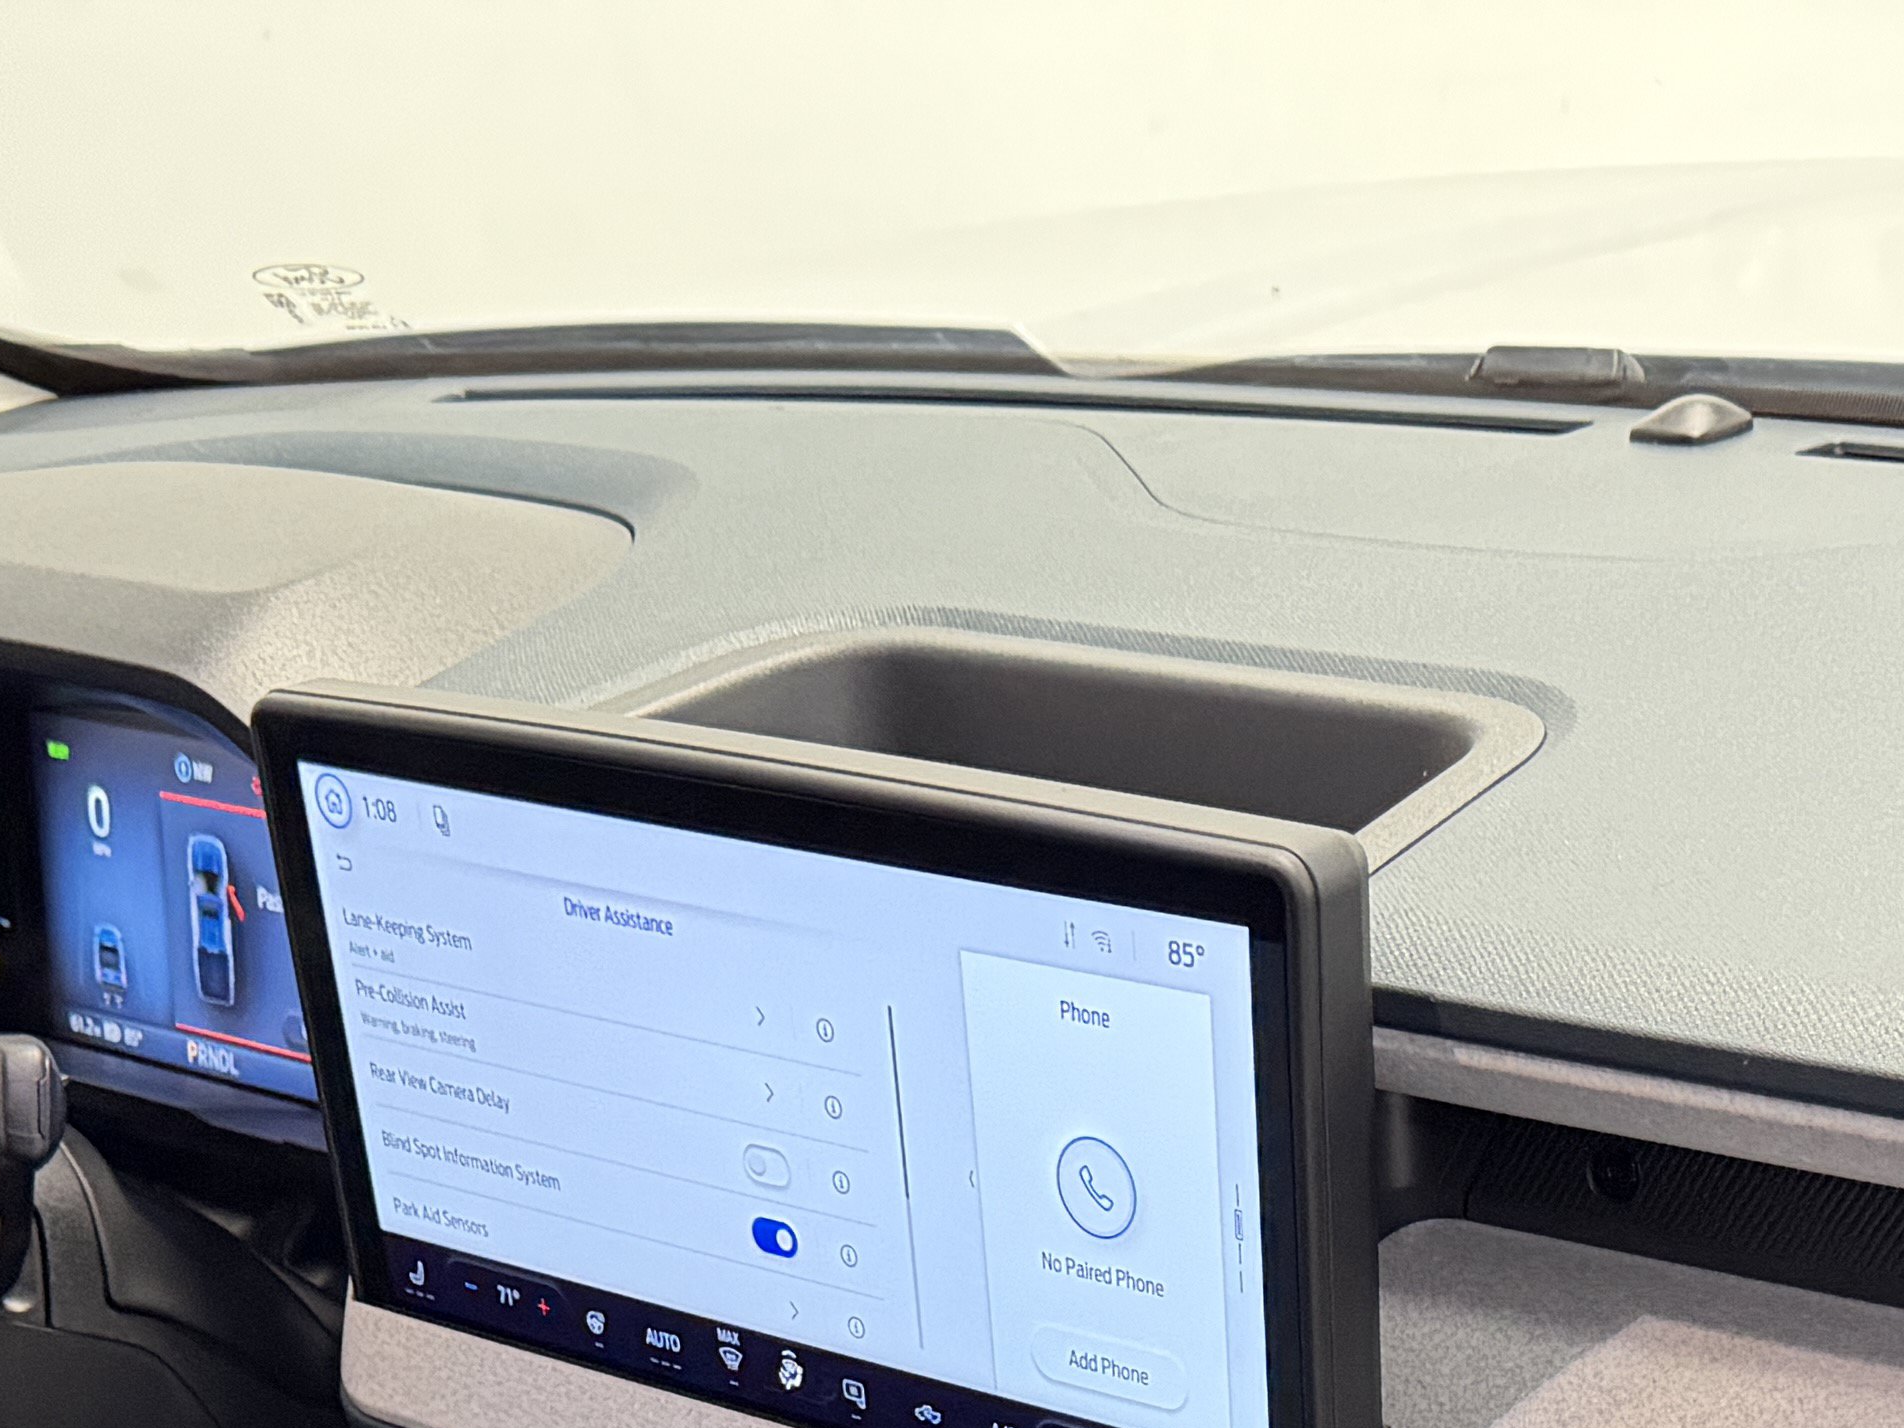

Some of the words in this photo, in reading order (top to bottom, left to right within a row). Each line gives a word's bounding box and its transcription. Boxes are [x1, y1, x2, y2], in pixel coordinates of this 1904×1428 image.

[88, 785, 110, 838] 0
[362, 796, 397, 823] 1:08
[342, 907, 425, 945] Lane-Keeping
[426, 924, 473, 951] System
[564, 896, 601, 922] Driver
[605, 906, 673, 936] Assistance
[1167, 939, 1206, 969] 85°
[355, 978, 429, 1011] Pre-Collision
[431, 994, 467, 1020] Assist
[1060, 999, 1110, 1028] Phone
[369, 1061, 396, 1078] Rear
[398, 1070, 427, 1091] View
[429, 1076, 475, 1103] Camera
[477, 1087, 510, 1114] Delay
[382, 1130, 412, 1153] Blind
[414, 1139, 442, 1160] Spot
[442, 1146, 514, 1179] Information
[515, 1163, 561, 1191] System
[393, 1197, 420, 1217] Park
[423, 1205, 442, 1225] Aid
[442, 1210, 489, 1238] Sensors
[1042, 1252, 1062, 1274] No
[1065, 1256, 1112, 1285] Paired
[1116, 1268, 1164, 1298] Phone
[646, 1327, 681, 1352] AUTO
[716, 1327, 741, 1346] MAX
[1069, 1349, 1098, 1372] Add
[1101, 1357, 1149, 1386] Phone
